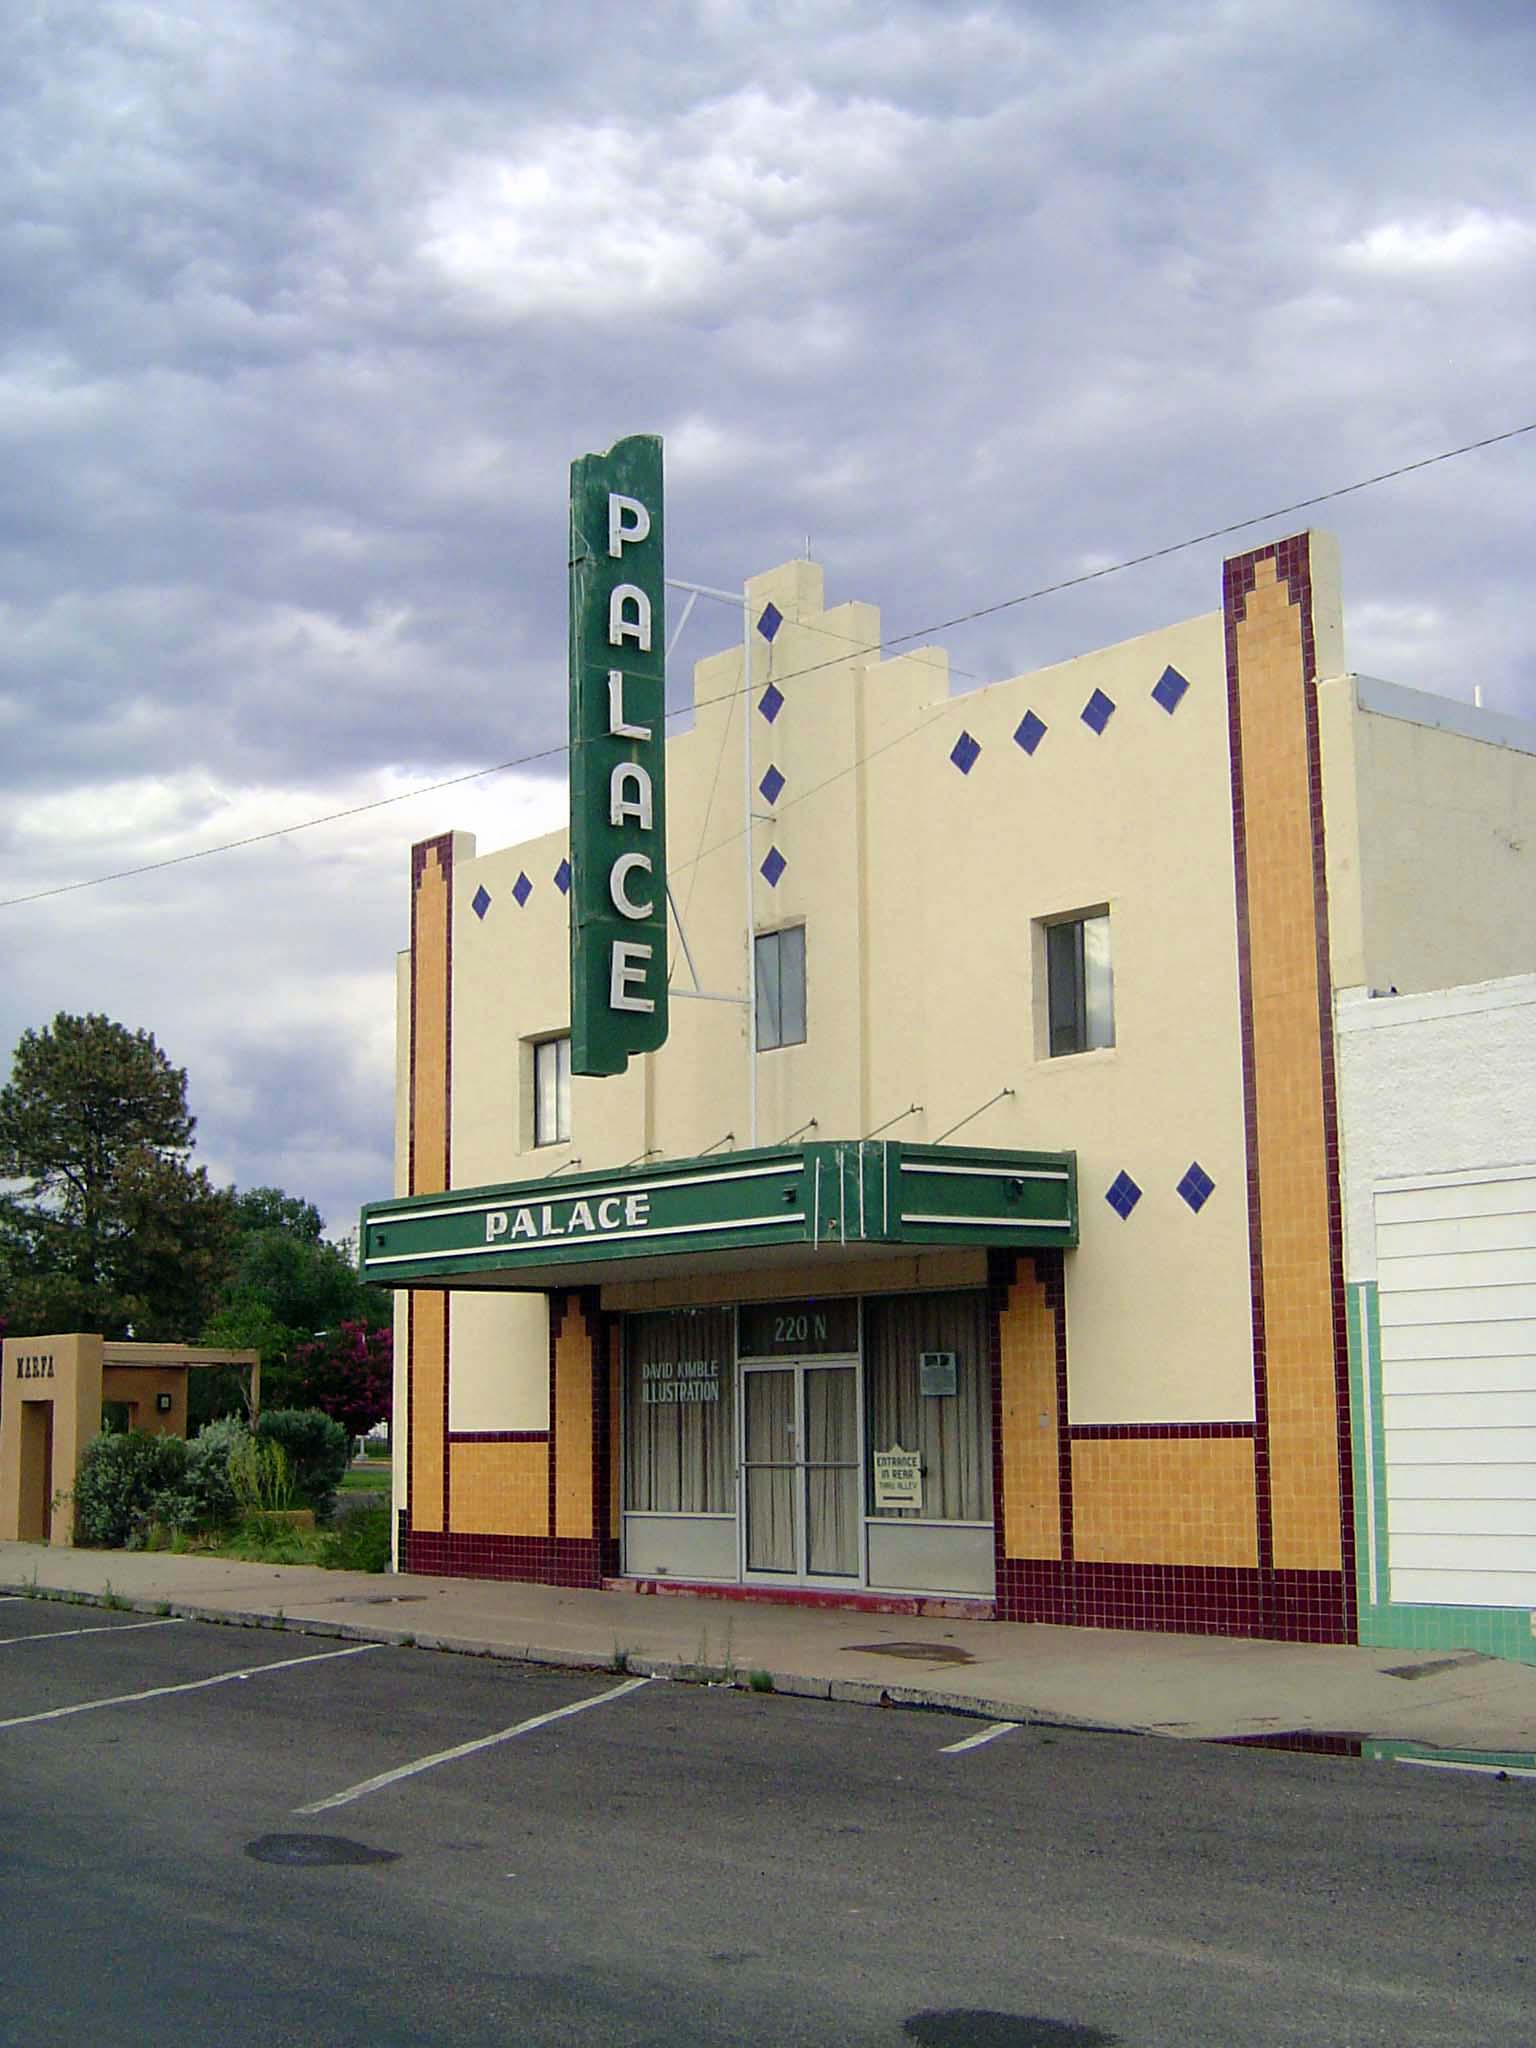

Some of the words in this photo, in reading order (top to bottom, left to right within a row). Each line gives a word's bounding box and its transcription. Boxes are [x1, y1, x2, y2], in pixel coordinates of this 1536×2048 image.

[608, 492, 656, 1013] PALACE
[486, 1193, 650, 1242] PALACE
[775, 1316, 808, 1342] 220
[815, 1314, 827, 1339] N
[16, 1355, 55, 1379] MARFA
[642, 1362, 673, 1380] DAVID
[677, 1359, 719, 1378] KIMBLE
[642, 1380, 720, 1403] ILLUSTRATION
[877, 1457, 917, 1467] ENTRANCE
[892, 1469, 914, 1479] REAR
